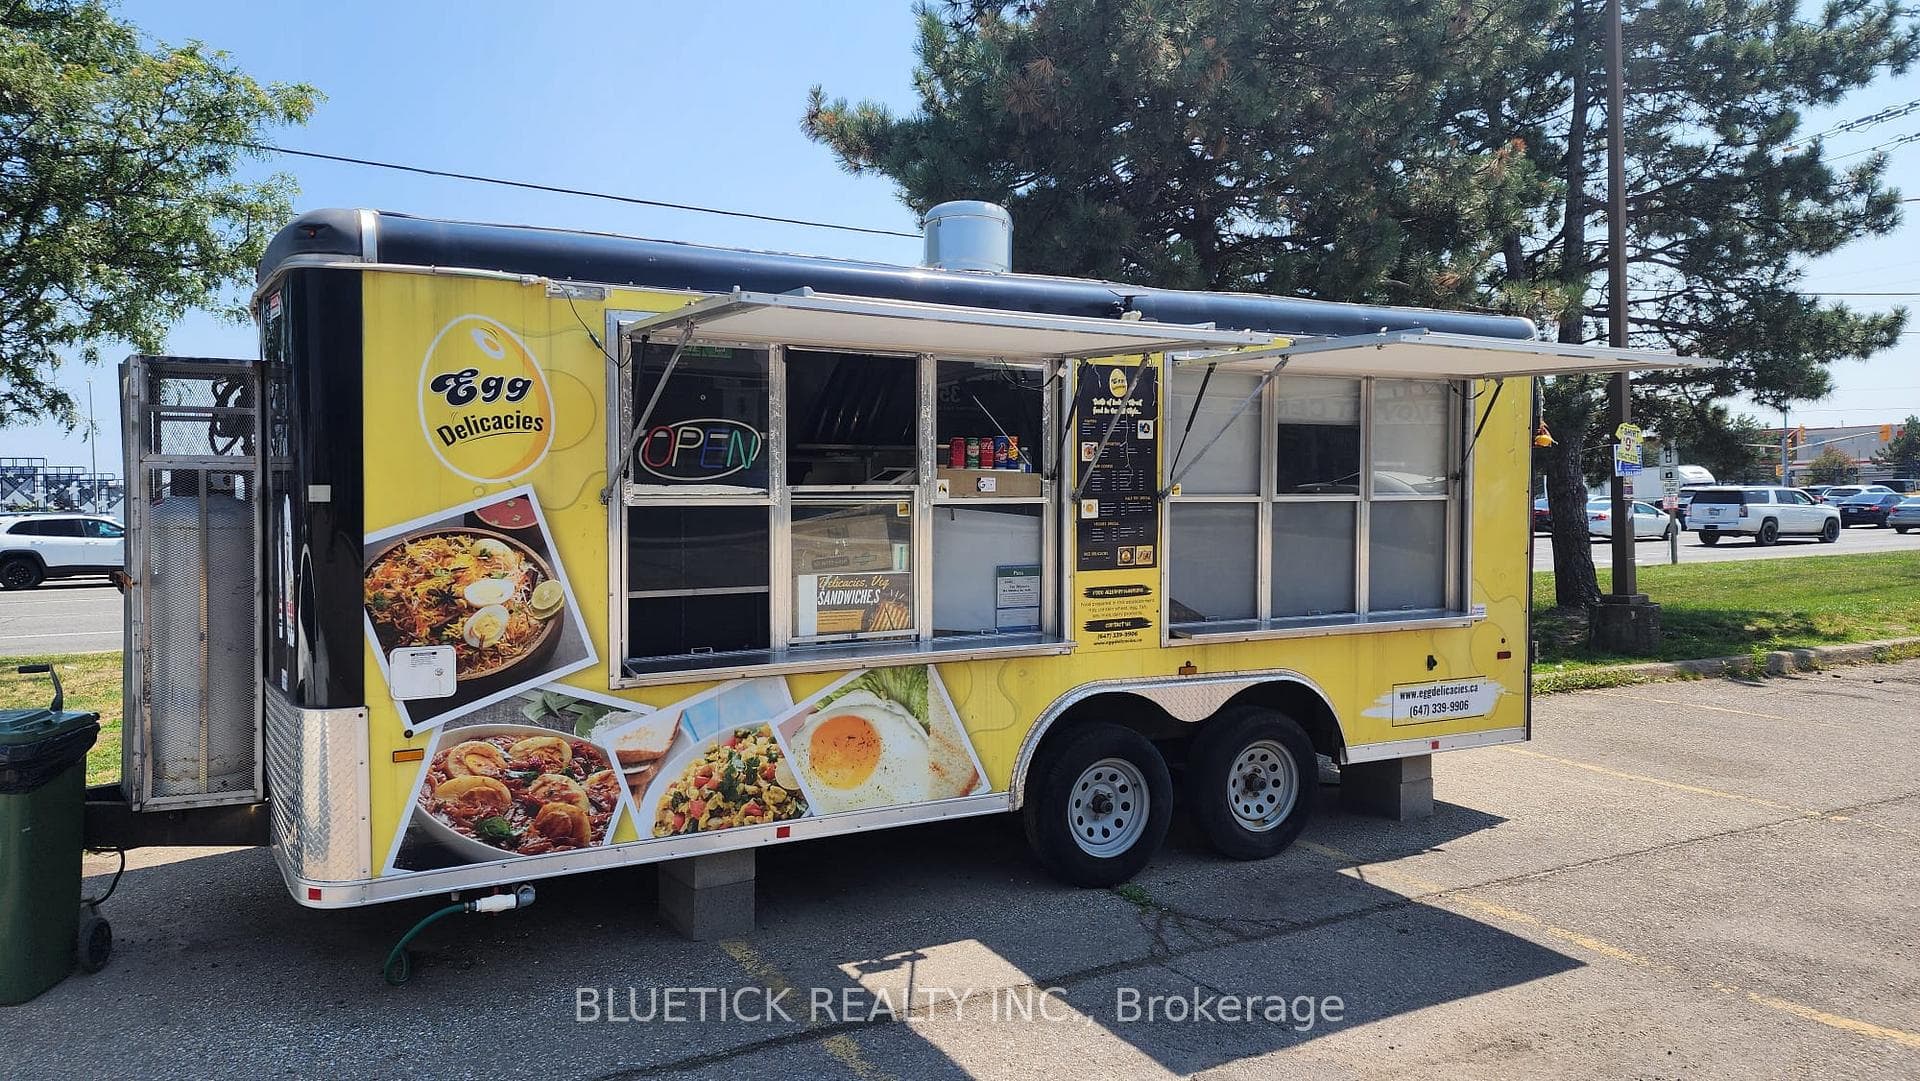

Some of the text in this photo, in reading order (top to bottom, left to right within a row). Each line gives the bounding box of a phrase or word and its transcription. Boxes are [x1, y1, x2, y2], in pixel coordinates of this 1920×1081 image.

[430, 368, 534, 407] Egg
[436, 410, 544, 447] Delicacies
[644, 425, 757, 470] OPEN
[870, 575, 891, 589] Veg
[1400, 683, 1479, 700] www.eggdelicacies.ca
[1409, 700, 1469, 718] (647) 339-9906
